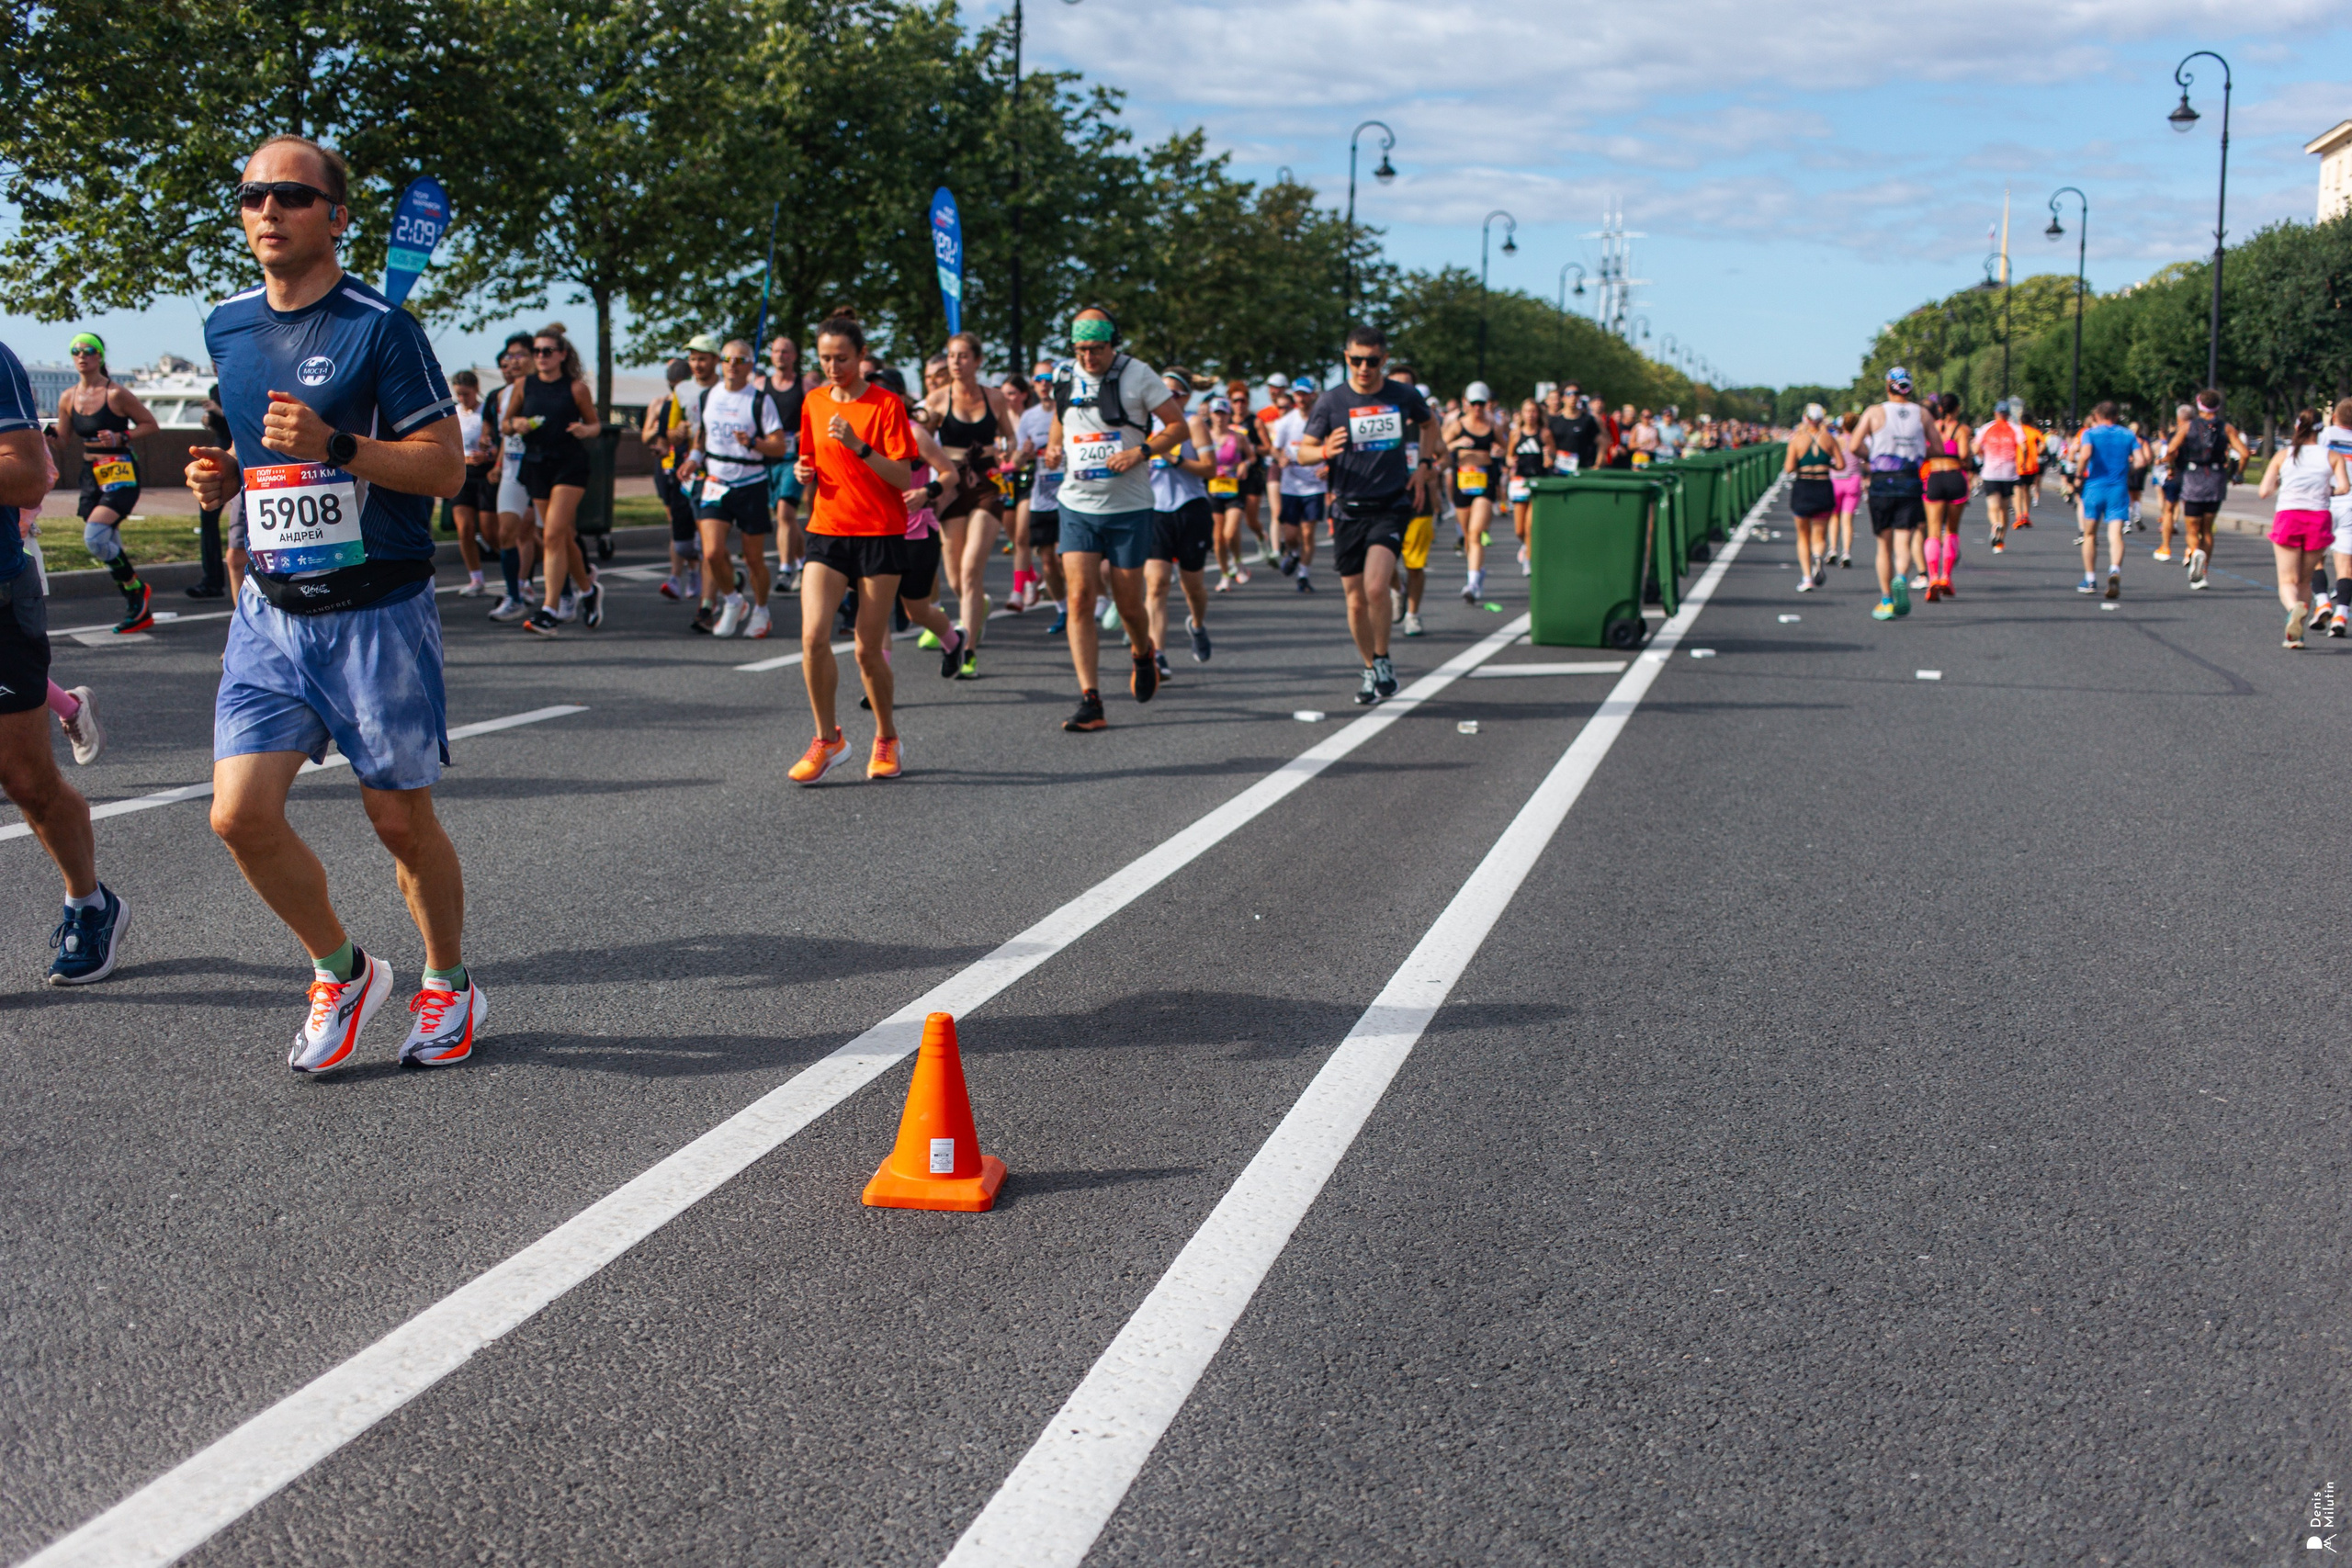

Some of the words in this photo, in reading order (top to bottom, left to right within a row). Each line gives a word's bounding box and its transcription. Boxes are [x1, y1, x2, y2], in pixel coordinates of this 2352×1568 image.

[396, 215, 436, 247] 2:09
[1358, 417, 1395, 434] 6735
[256, 468, 272, 477] ПОЛУ
[256, 474, 287, 483] МАРАФОН
[300, 470, 318, 480] 21,1
[259, 493, 343, 531] 5908
[279, 527, 323, 543] АНДРЕЙ
